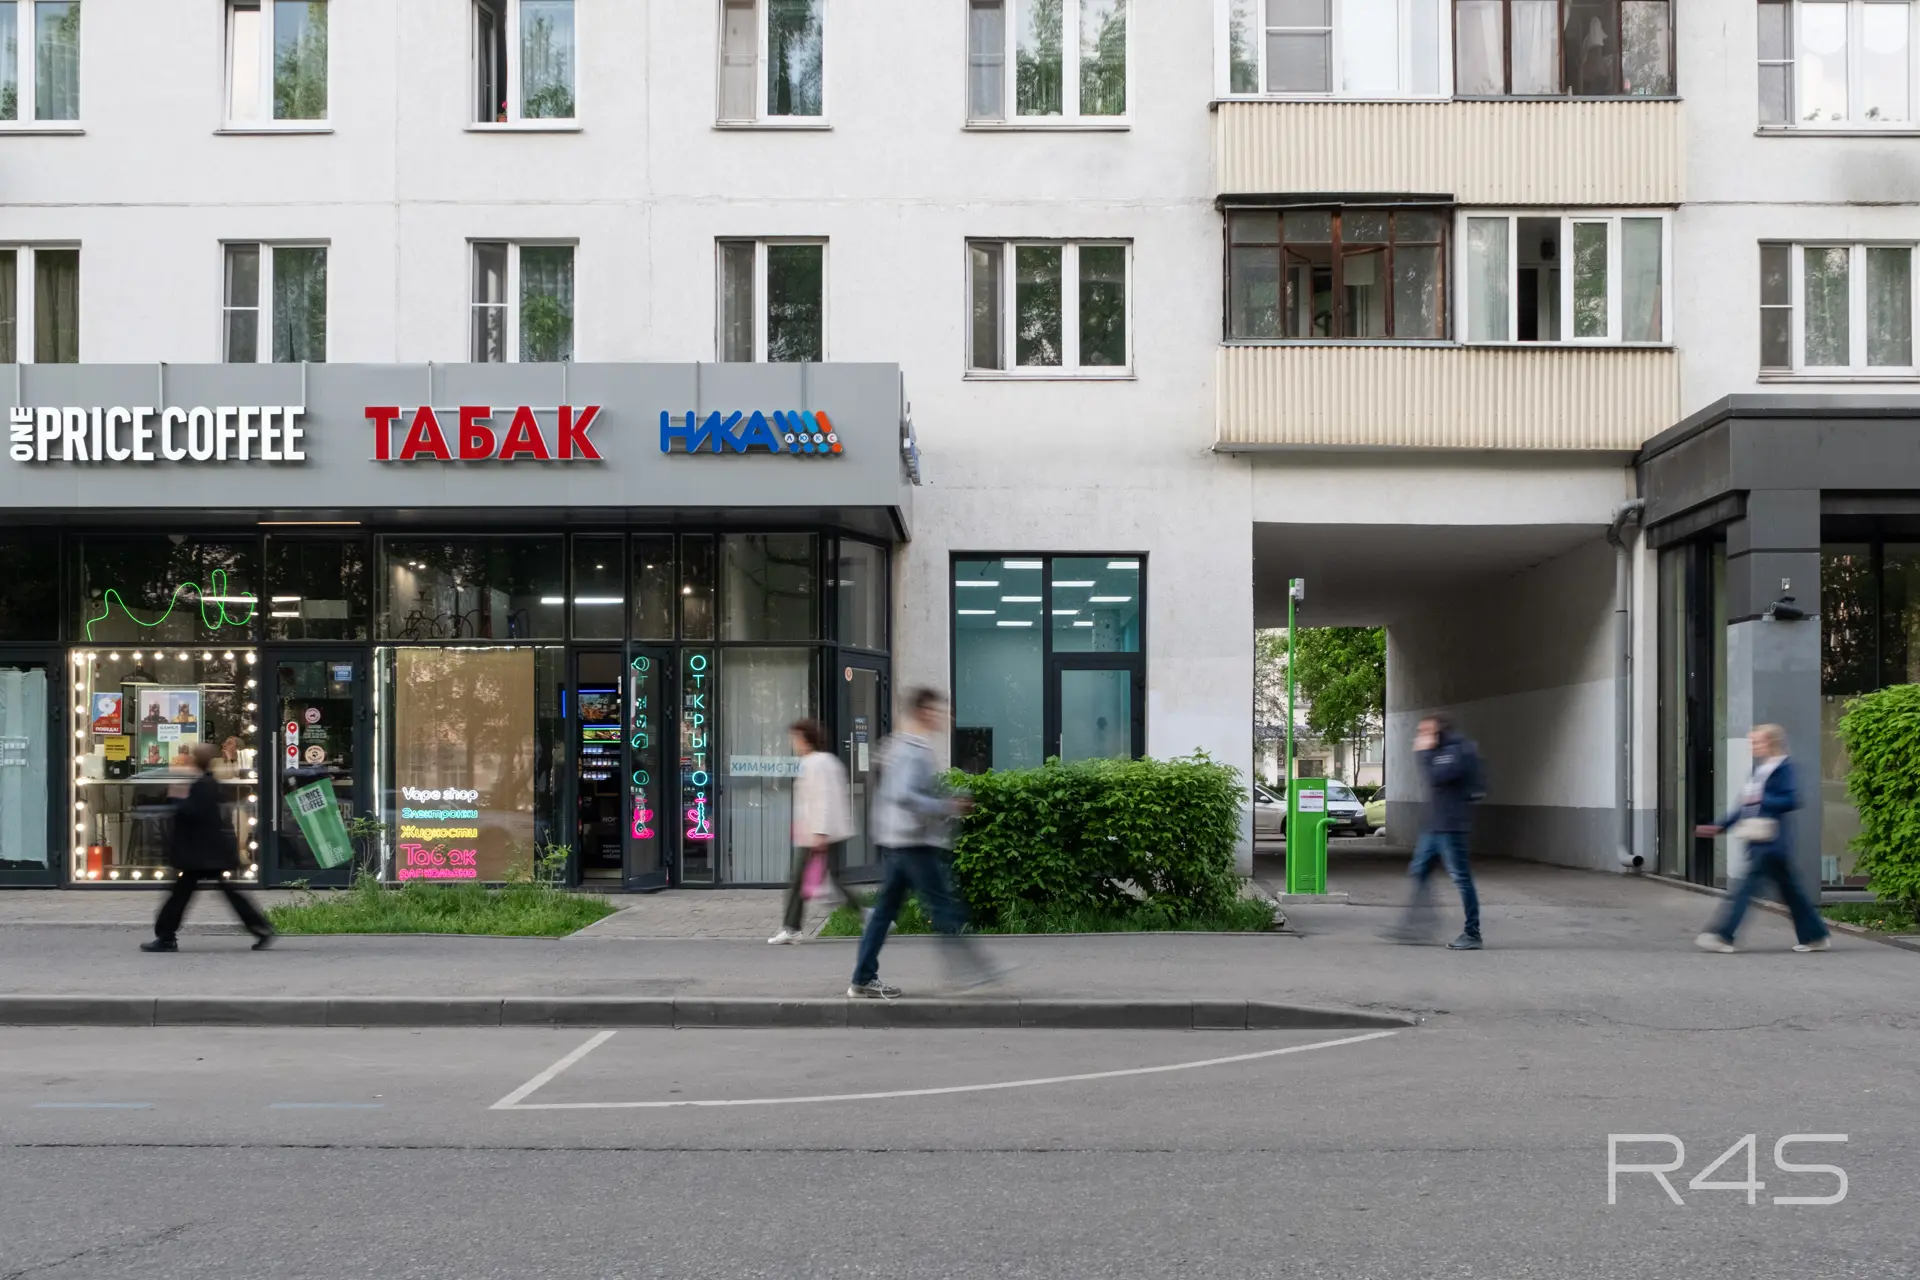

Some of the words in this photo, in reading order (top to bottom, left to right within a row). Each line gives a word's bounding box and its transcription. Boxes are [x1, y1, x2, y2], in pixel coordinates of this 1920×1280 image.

[10, 407, 34, 462] ONE
[37, 407, 155, 461] PRICE
[161, 406, 305, 461] COFFEE
[365, 405, 603, 461] ТАБАК
[660, 410, 780, 453] НИКА
[690, 655, 708, 786] ОТКРЫТО
[731, 761, 805, 773] ХИМЧИСТК
[402, 786, 441, 803] Vape
[443, 787, 478, 803] shop
[402, 807, 478, 820] Электронки
[401, 825, 478, 841] Жидкости
[400, 843, 476, 866] Табак
